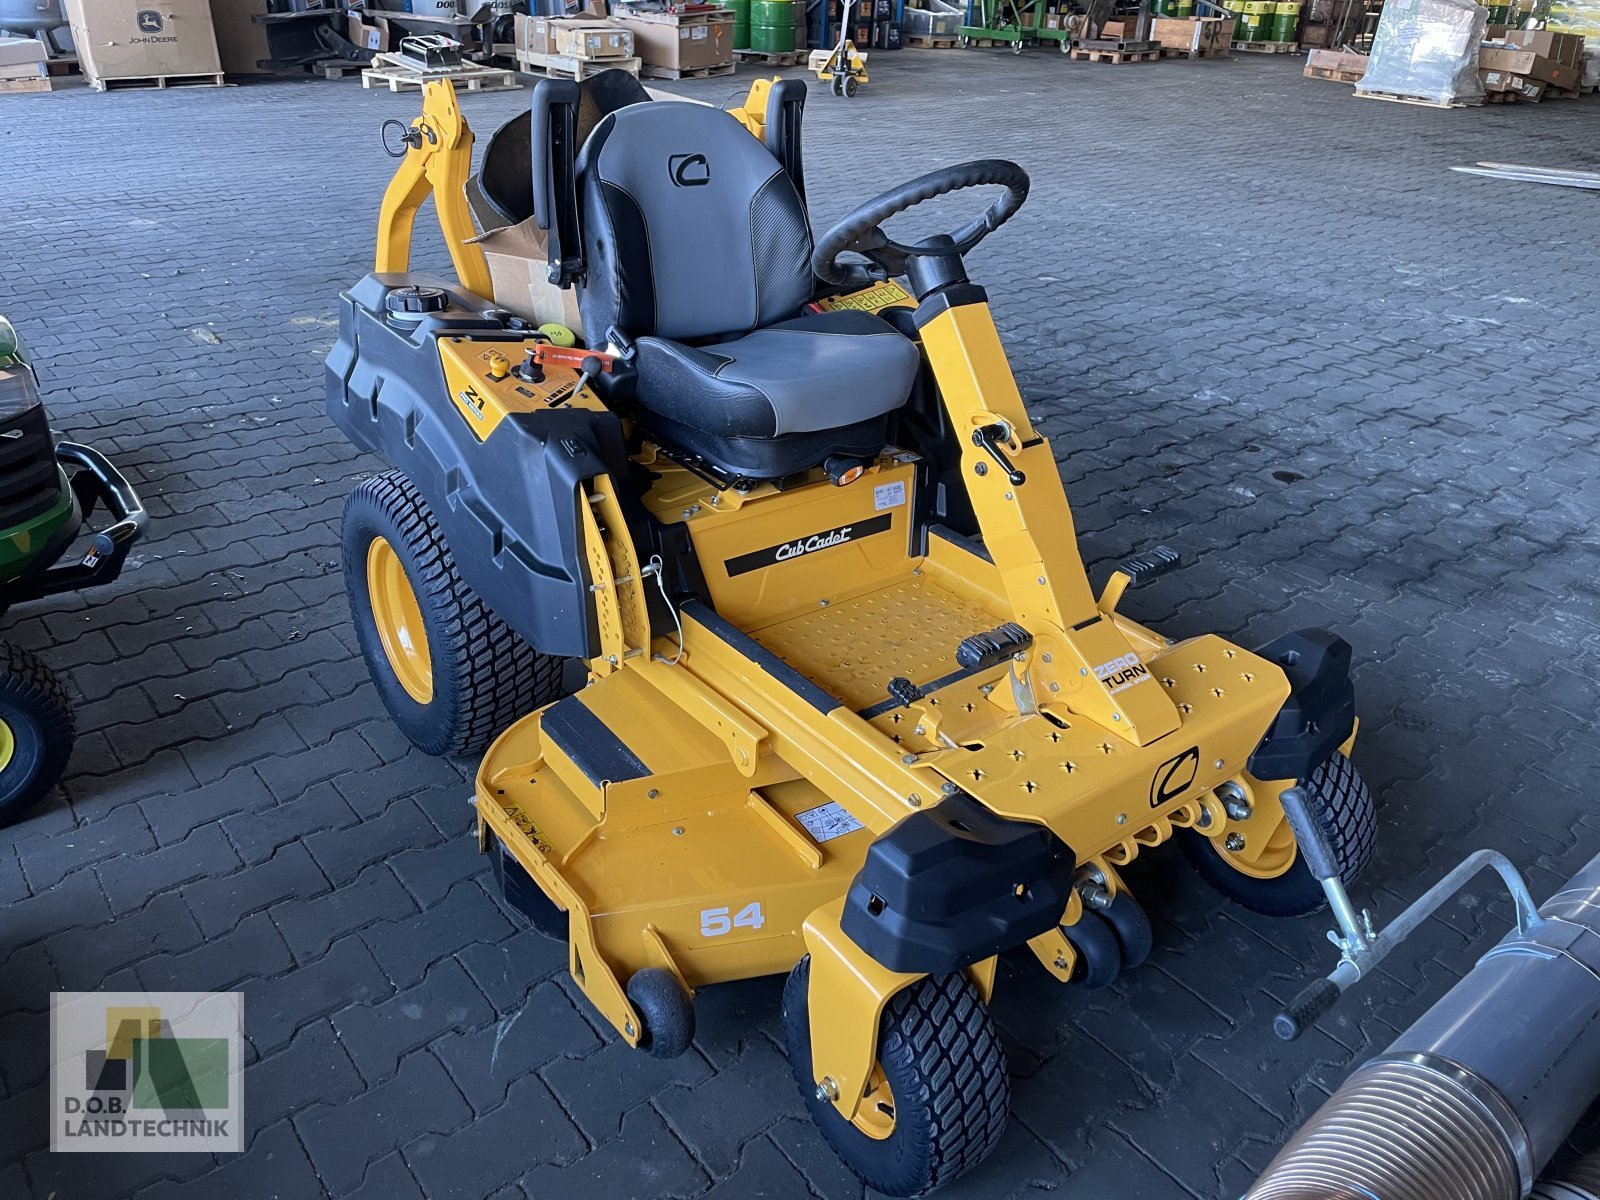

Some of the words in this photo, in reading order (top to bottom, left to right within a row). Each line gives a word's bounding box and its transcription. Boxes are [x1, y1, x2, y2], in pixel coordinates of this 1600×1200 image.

[464, 384, 485, 411] Z1
[775, 541, 804, 561] Cub
[804, 527, 852, 553] Cadet
[1094, 652, 1140, 679] ZERO
[1102, 663, 1147, 689] TURN
[701, 902, 764, 937] 54
